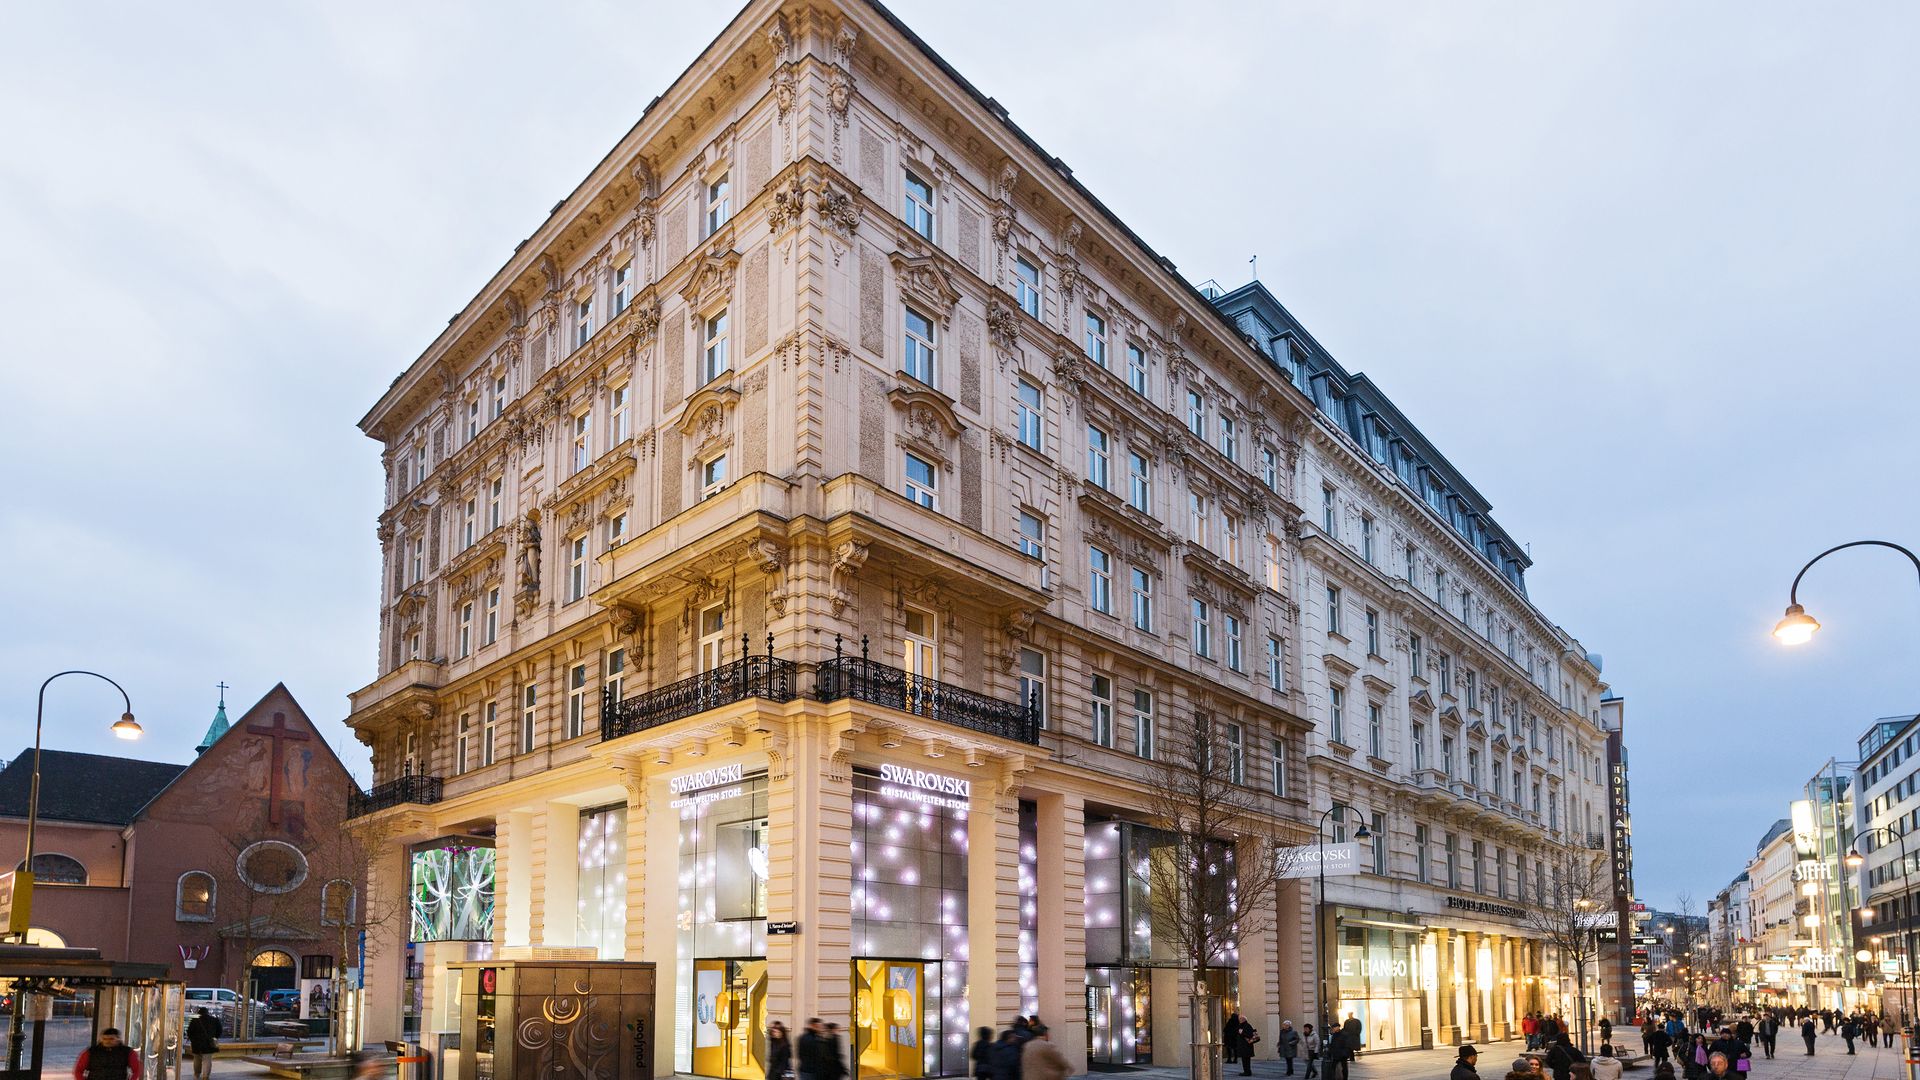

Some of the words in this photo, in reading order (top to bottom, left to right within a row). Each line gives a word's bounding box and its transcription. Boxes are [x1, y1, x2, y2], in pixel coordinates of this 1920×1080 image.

[670, 764, 743, 794] SWAROVSKI
[880, 763, 970, 797] SWAROVSKI
[1612, 765, 1622, 816] HOTEL
[720, 788, 742, 800] STORE
[881, 786, 945, 806] KRISTALLWELTEN
[946, 799, 970, 811] STORE
[1615, 829, 1625, 892] EUROPA
[1795, 861, 1832, 880] STEFFL
[1799, 954, 1836, 972] STEFFL
